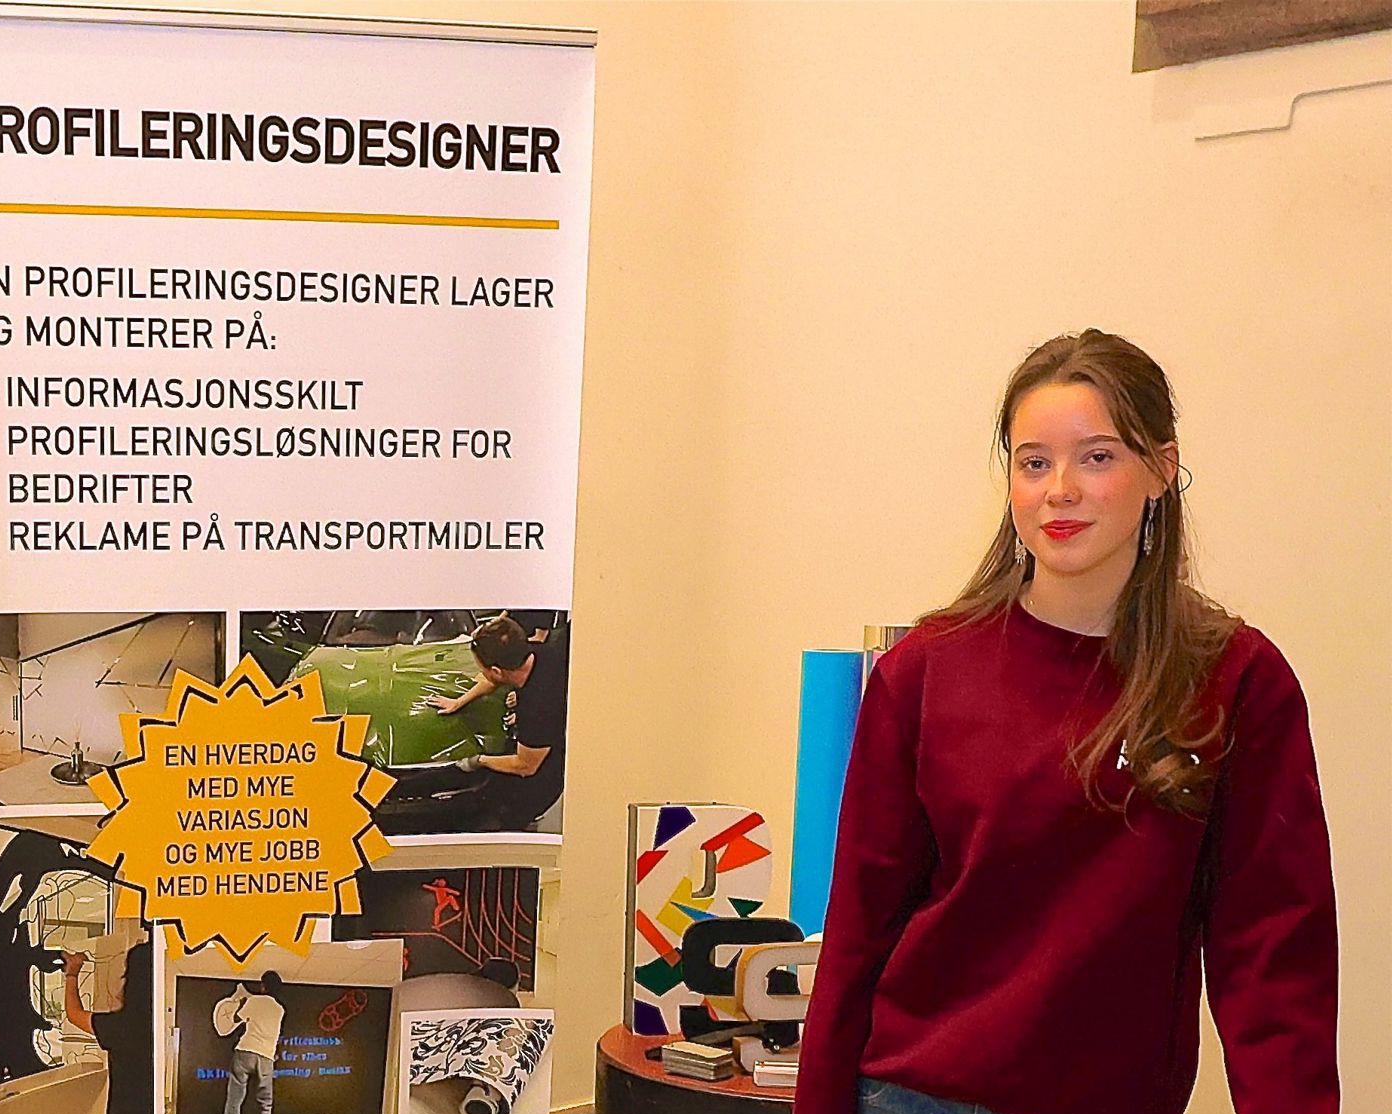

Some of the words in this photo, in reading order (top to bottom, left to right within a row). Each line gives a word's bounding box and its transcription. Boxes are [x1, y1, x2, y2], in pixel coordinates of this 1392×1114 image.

[25, 265, 440, 306] PROFILERINGSDESIGNER
[451, 276, 554, 309] LAGER
[26, 315, 213, 349] MONTERER
[225, 310, 278, 350] PÅ:
[7, 376, 364, 410] INFORMASJONSSKILT
[8, 425, 441, 459] PROFILERINGSLØSNINGER
[452, 429, 512, 459] FOR
[8, 473, 193, 504] BEDRIFTER
[9, 521, 171, 551] REKLAME
[182, 512, 226, 551] PÅ
[234, 521, 545, 551] TRANSPORTMIDLER
[165, 744, 196, 767] EN
[205, 742, 317, 766] HVERDAG
[187, 777, 239, 799] MED
[247, 775, 295, 798] MYE
[176, 807, 308, 832] VARIASJON
[165, 843, 197, 865] OG
[205, 841, 253, 864] MYE
[259, 839, 320, 862] JOBB
[157, 875, 208, 898] MED
[216, 870, 329, 895] HENDENE
